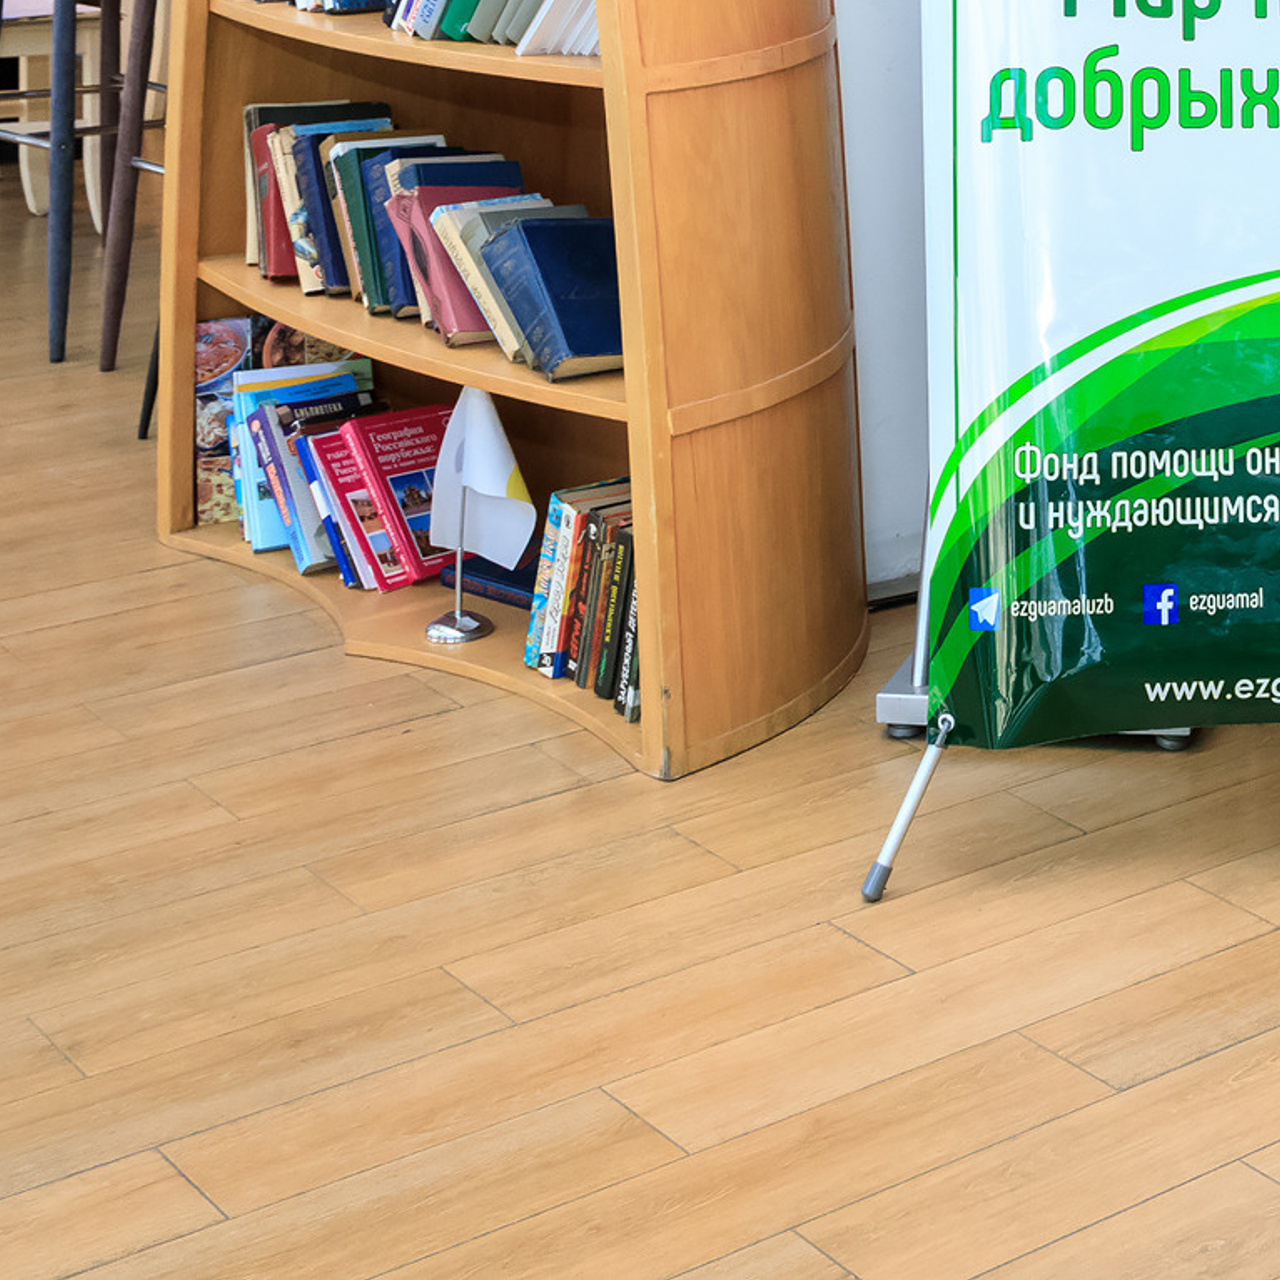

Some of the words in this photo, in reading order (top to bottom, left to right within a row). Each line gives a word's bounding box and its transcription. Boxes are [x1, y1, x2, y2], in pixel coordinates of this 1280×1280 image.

[980, 43, 1280, 152] добрых
[1014, 441, 1100, 484] Фонд
[1111, 445, 1235, 482] помощи
[1019, 502, 1036, 529] и
[1048, 495, 1280, 540] нуждающимся
[1010, 594, 1115, 625] ezguamaluzb
[1189, 587, 1264, 615] ezguamal
